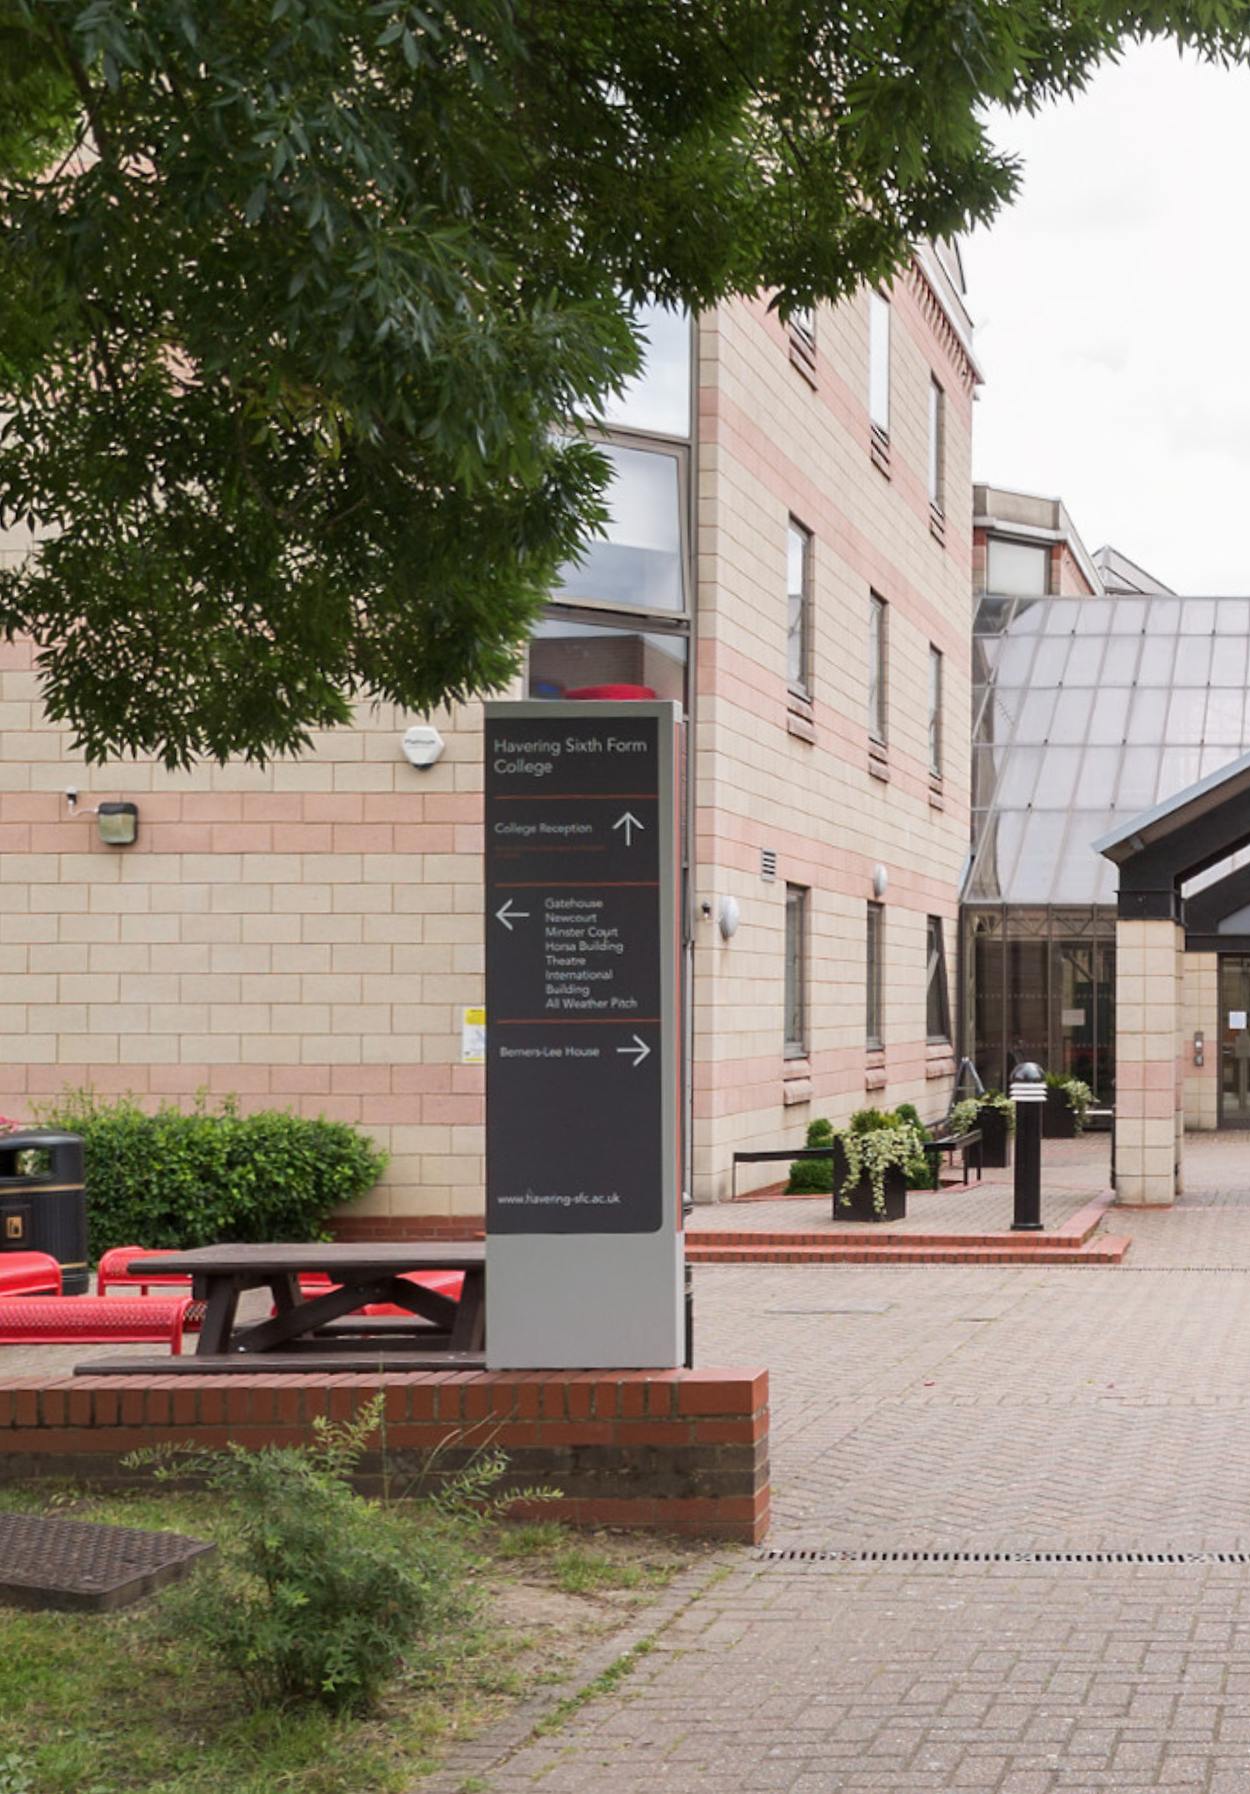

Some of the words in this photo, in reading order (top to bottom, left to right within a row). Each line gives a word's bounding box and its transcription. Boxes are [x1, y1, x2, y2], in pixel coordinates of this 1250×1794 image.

[494, 738, 561, 756] Havering
[565, 737, 602, 753] Sixth
[607, 737, 648, 753] Form
[494, 759, 553, 777] College
[494, 823, 537, 835] College
[539, 822, 593, 837] Reception
[545, 898, 604, 909] Gatehouse
[545, 912, 598, 923] Newcourt
[545, 926, 585, 937] Minster
[587, 926, 619, 938] Court
[545, 941, 577, 952] Horsa
[579, 940, 624, 954] Building
[546, 955, 586, 966] Theatre
[545, 969, 614, 980] International
[546, 984, 590, 997] Building
[545, 998, 560, 1009] All
[562, 998, 608, 1009] Weather
[610, 997, 638, 1009] Pitch
[500, 1046, 563, 1057] Berners-Lee
[565, 1046, 600, 1057] House
[498, 1191, 621, 1206] www.havering-sfc.ac.uk
